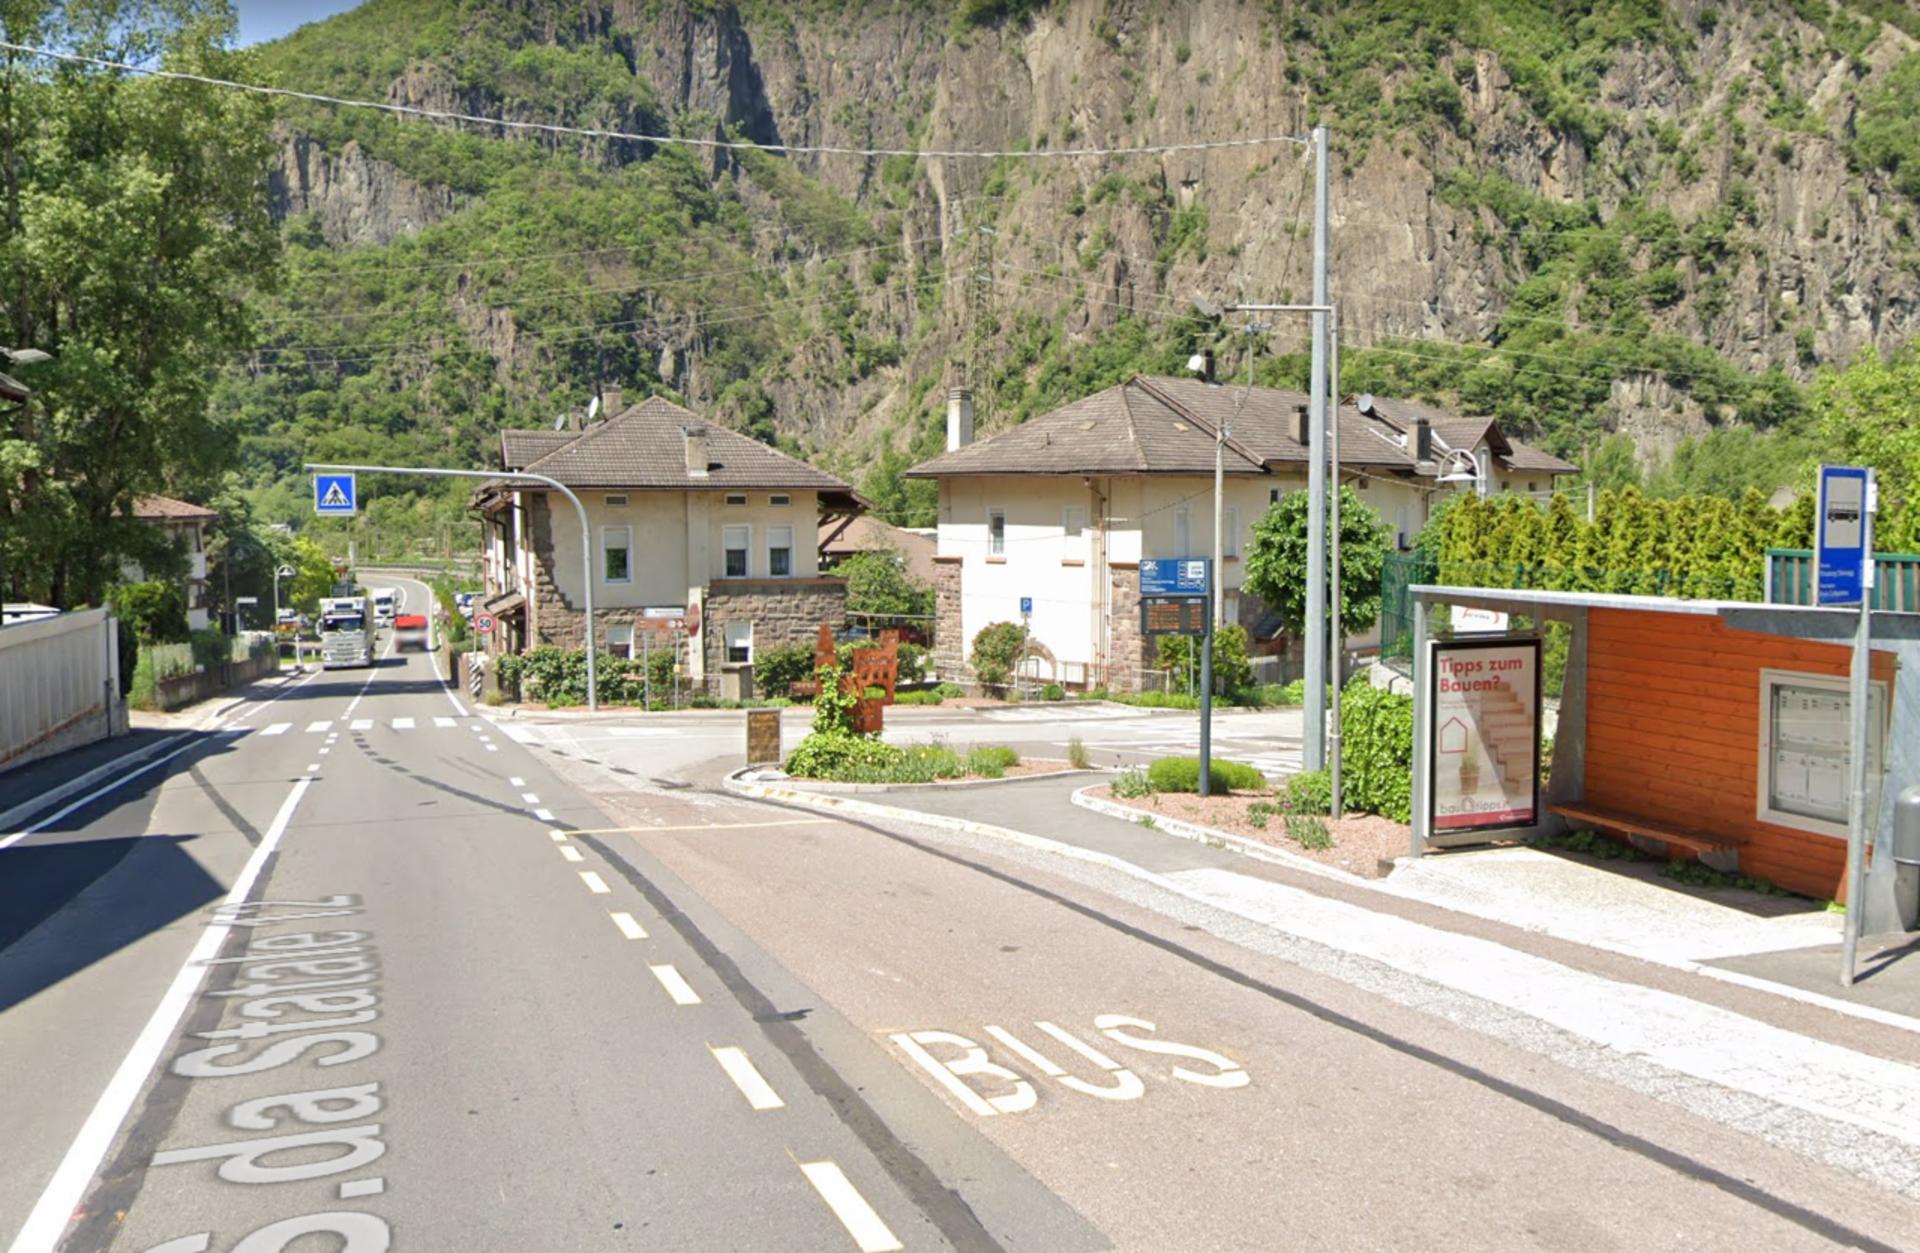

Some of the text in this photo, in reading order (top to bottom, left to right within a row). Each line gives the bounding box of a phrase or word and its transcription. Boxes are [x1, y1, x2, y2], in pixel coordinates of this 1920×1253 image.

[480, 618, 491, 628] 50
[1440, 657, 1523, 677] Tipps zum
[1440, 675, 1501, 692] Bauen?
[888, 1014, 1251, 1116] BUS
